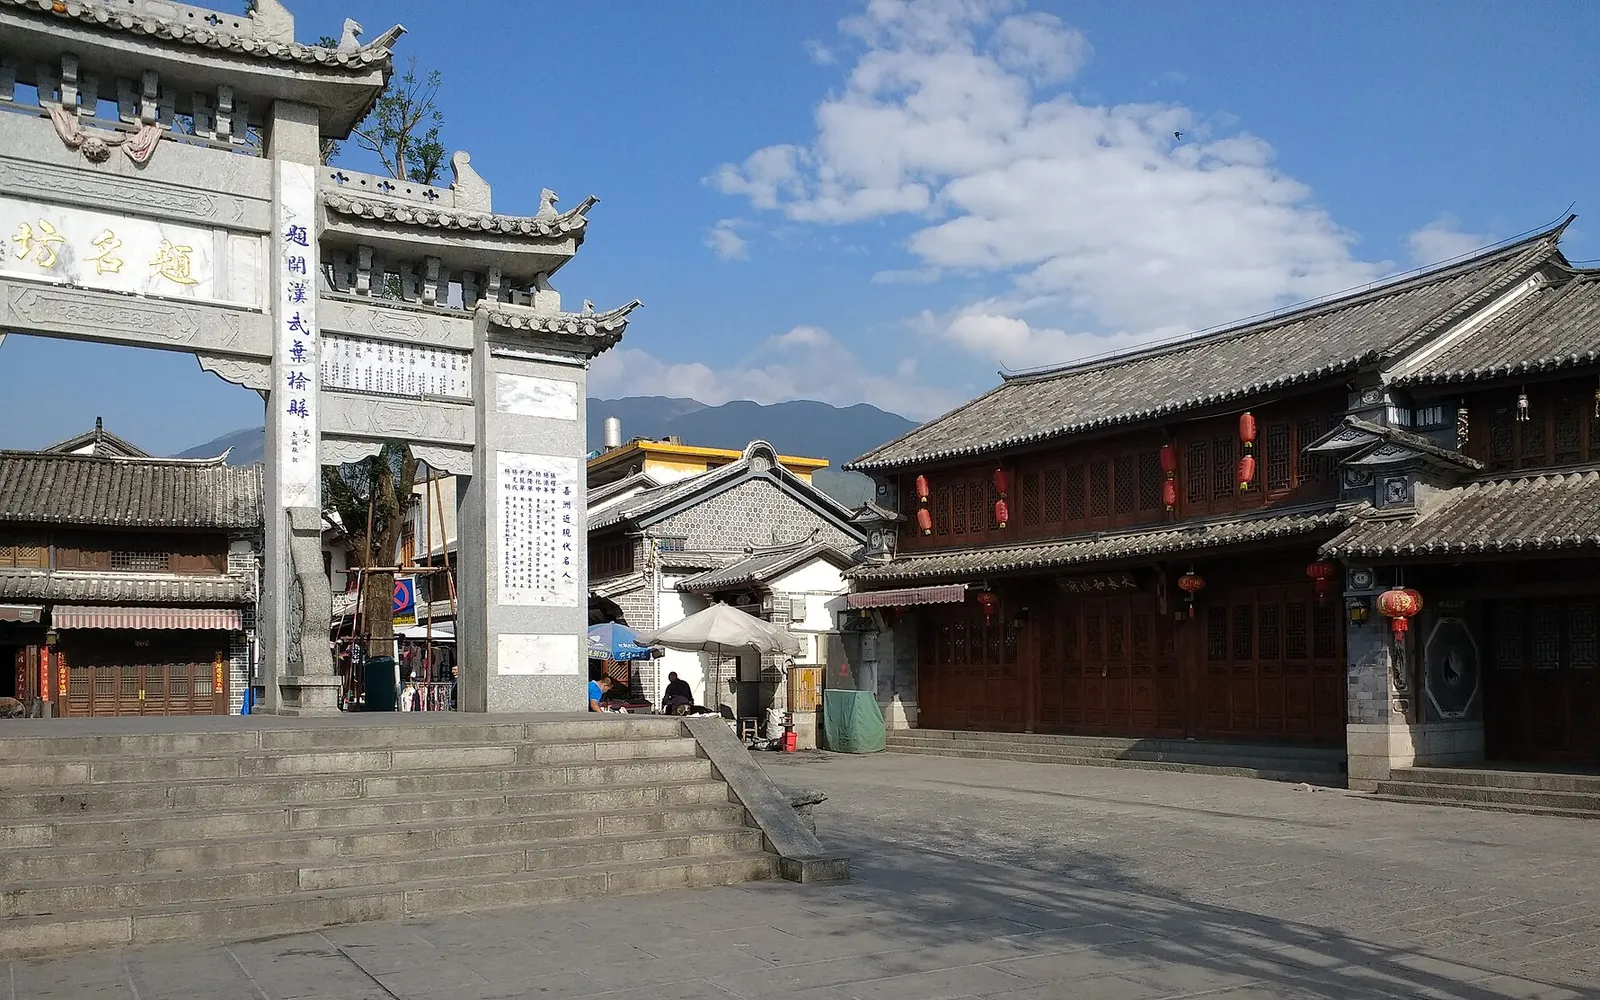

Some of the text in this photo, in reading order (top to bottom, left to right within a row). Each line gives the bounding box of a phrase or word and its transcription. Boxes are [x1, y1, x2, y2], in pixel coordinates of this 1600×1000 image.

[12, 218, 199, 285] 題名坊
[562, 486, 572, 579] 喜洲近現代名人
